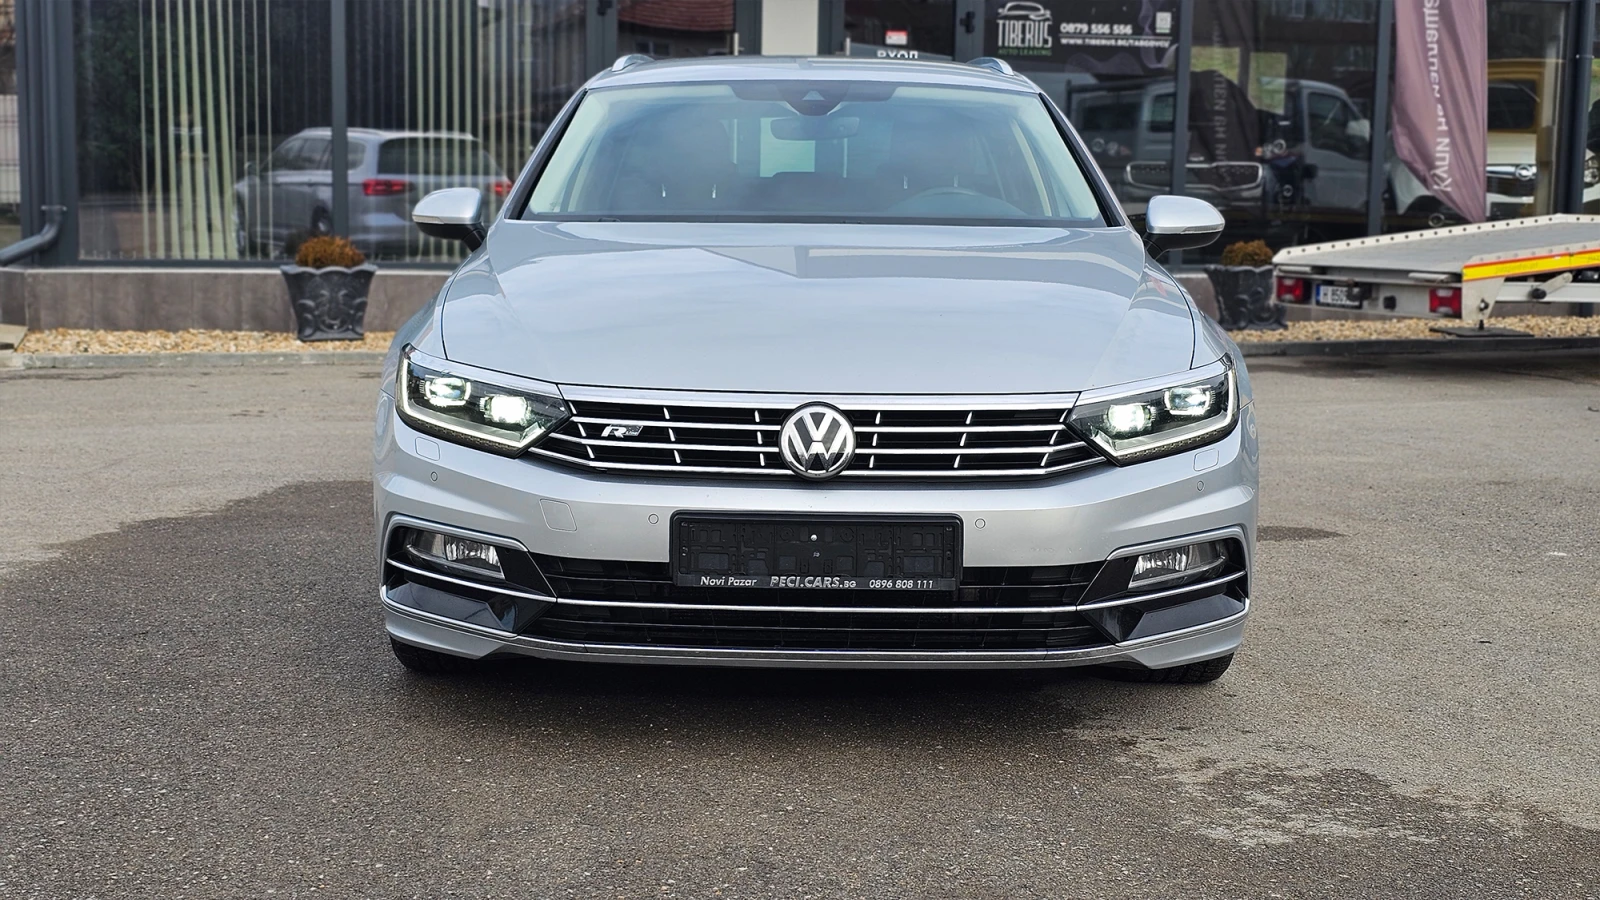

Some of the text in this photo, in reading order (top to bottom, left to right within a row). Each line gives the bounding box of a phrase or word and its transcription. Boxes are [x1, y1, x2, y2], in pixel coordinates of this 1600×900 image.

[996, 19, 1053, 48] TIBERUS
[1060, 22, 1133, 35] 0879 556 556
[1019, 48, 1052, 56] LEASING
[600, 425, 627, 439] R
[700, 576, 934, 589] Novi Pazar PECI.CARS.BG 0896 808 111
